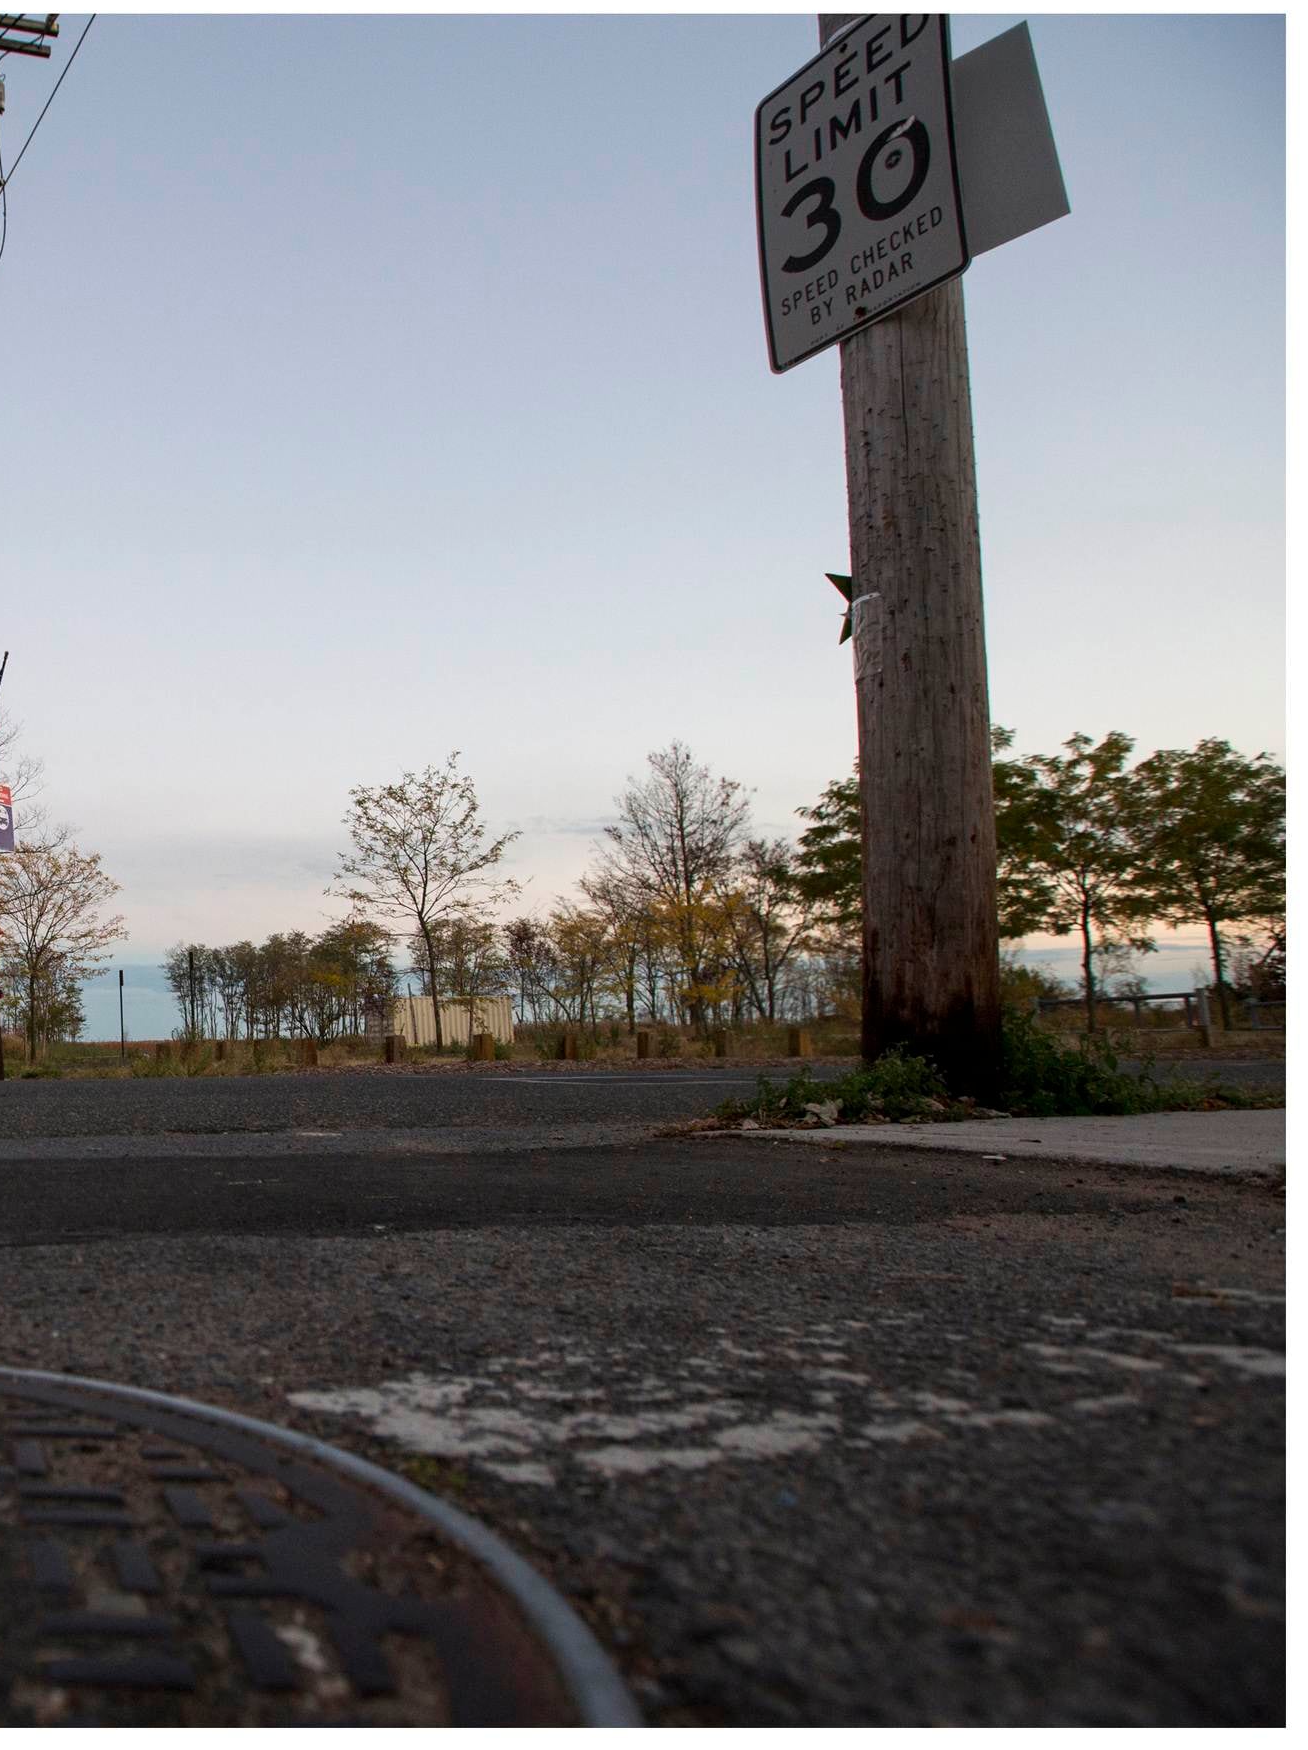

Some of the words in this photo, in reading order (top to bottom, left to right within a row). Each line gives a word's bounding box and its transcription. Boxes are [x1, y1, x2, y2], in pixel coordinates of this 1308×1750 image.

[769, 14, 930, 146] SPEED
[785, 61, 911, 183] LIMIT
[780, 117, 930, 274] 30
[781, 269, 839, 316] SPEED
[850, 206, 942, 274] CHECKED
[810, 296, 833, 325] BY
[846, 252, 914, 306] RADAR
